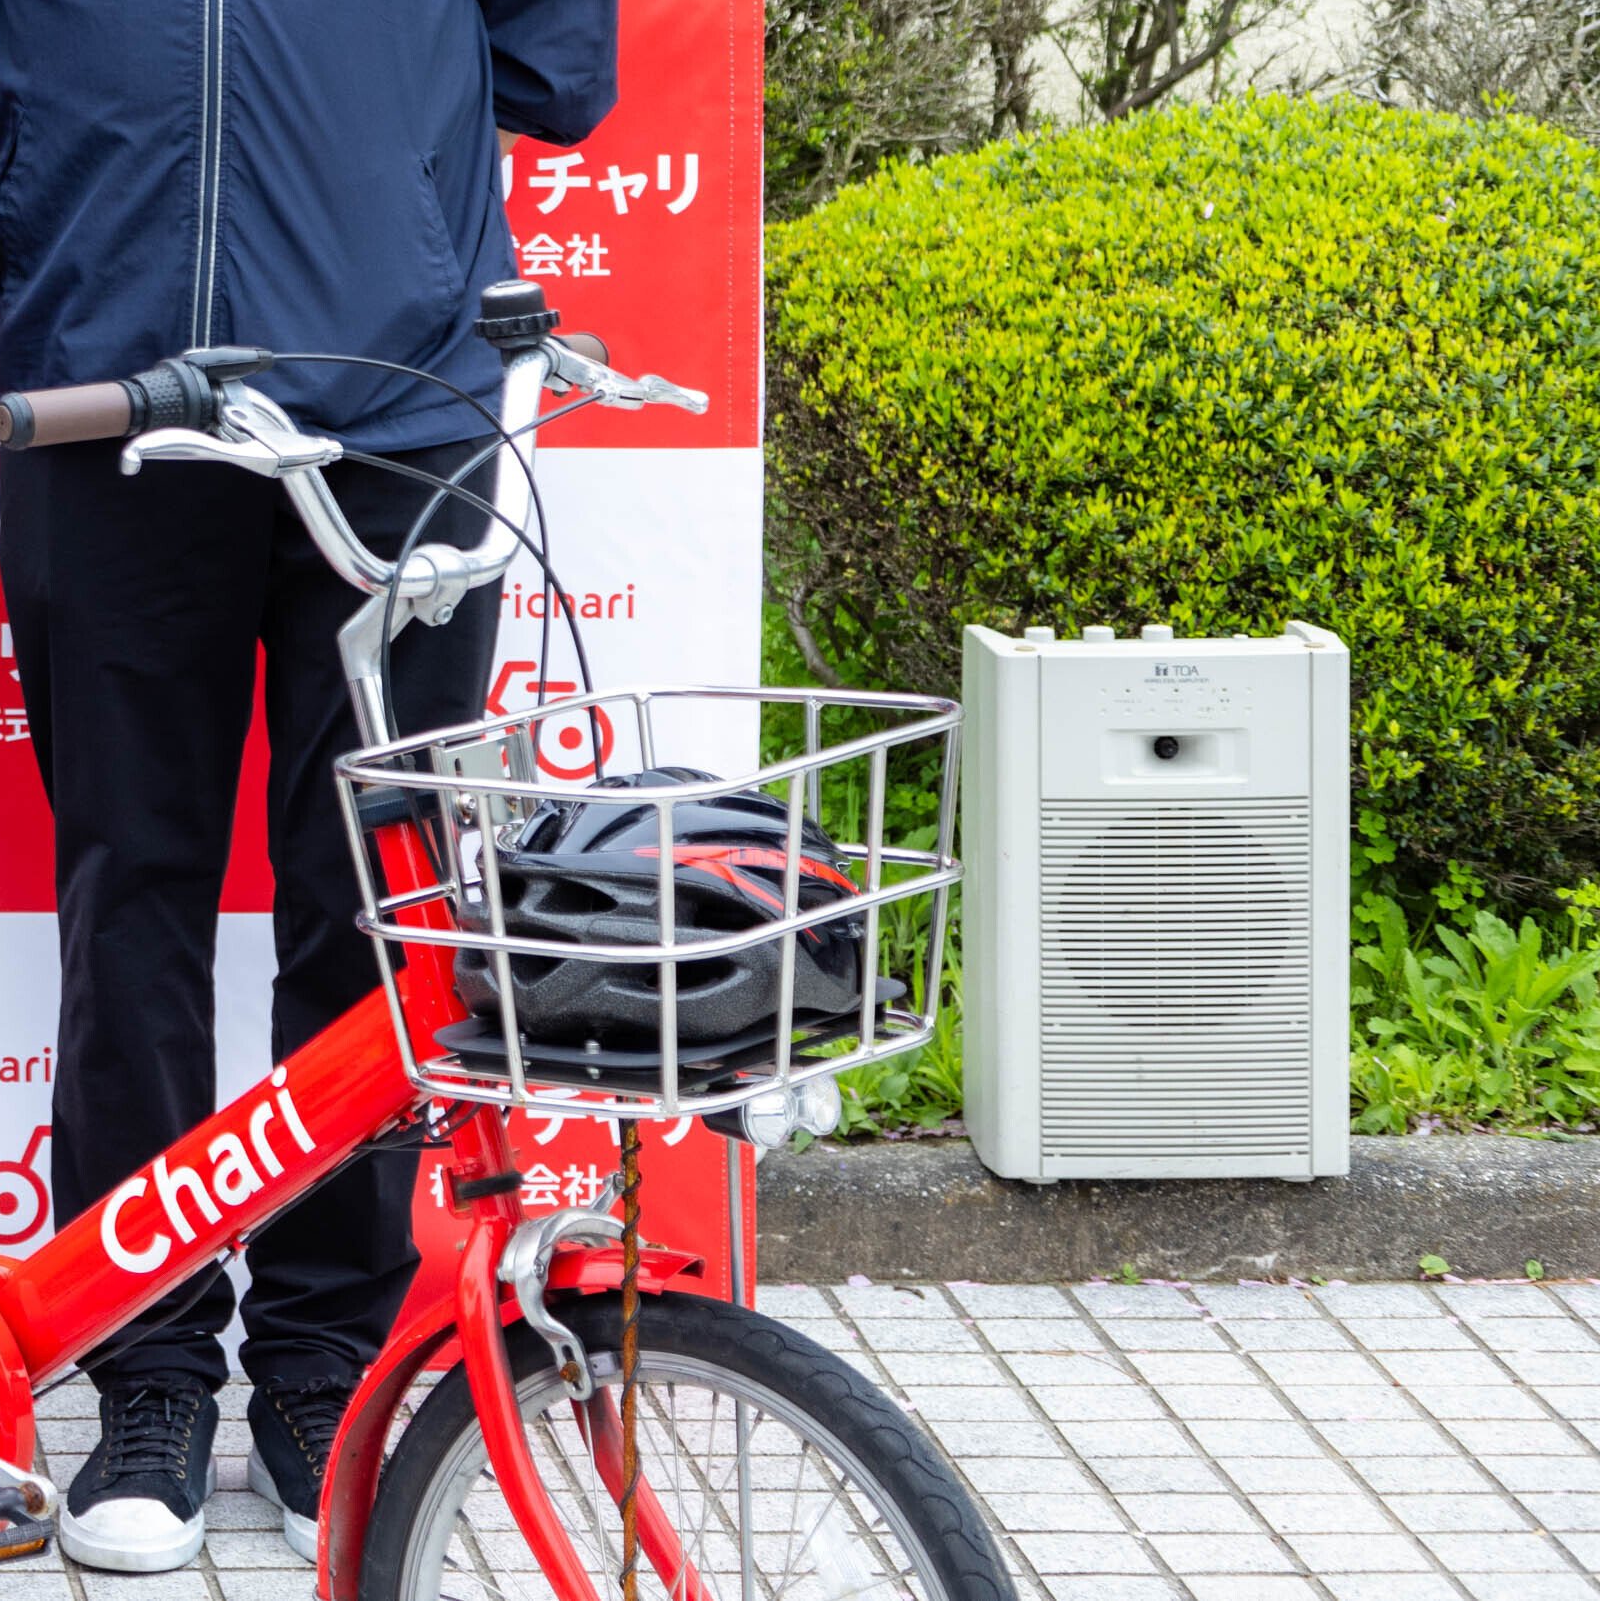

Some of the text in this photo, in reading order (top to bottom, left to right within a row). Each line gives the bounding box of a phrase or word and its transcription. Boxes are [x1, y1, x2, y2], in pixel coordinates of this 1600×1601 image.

[512, 232, 611, 278] 会社
[1172, 664, 1199, 677] TOA
[100, 1065, 317, 1274] Chari
